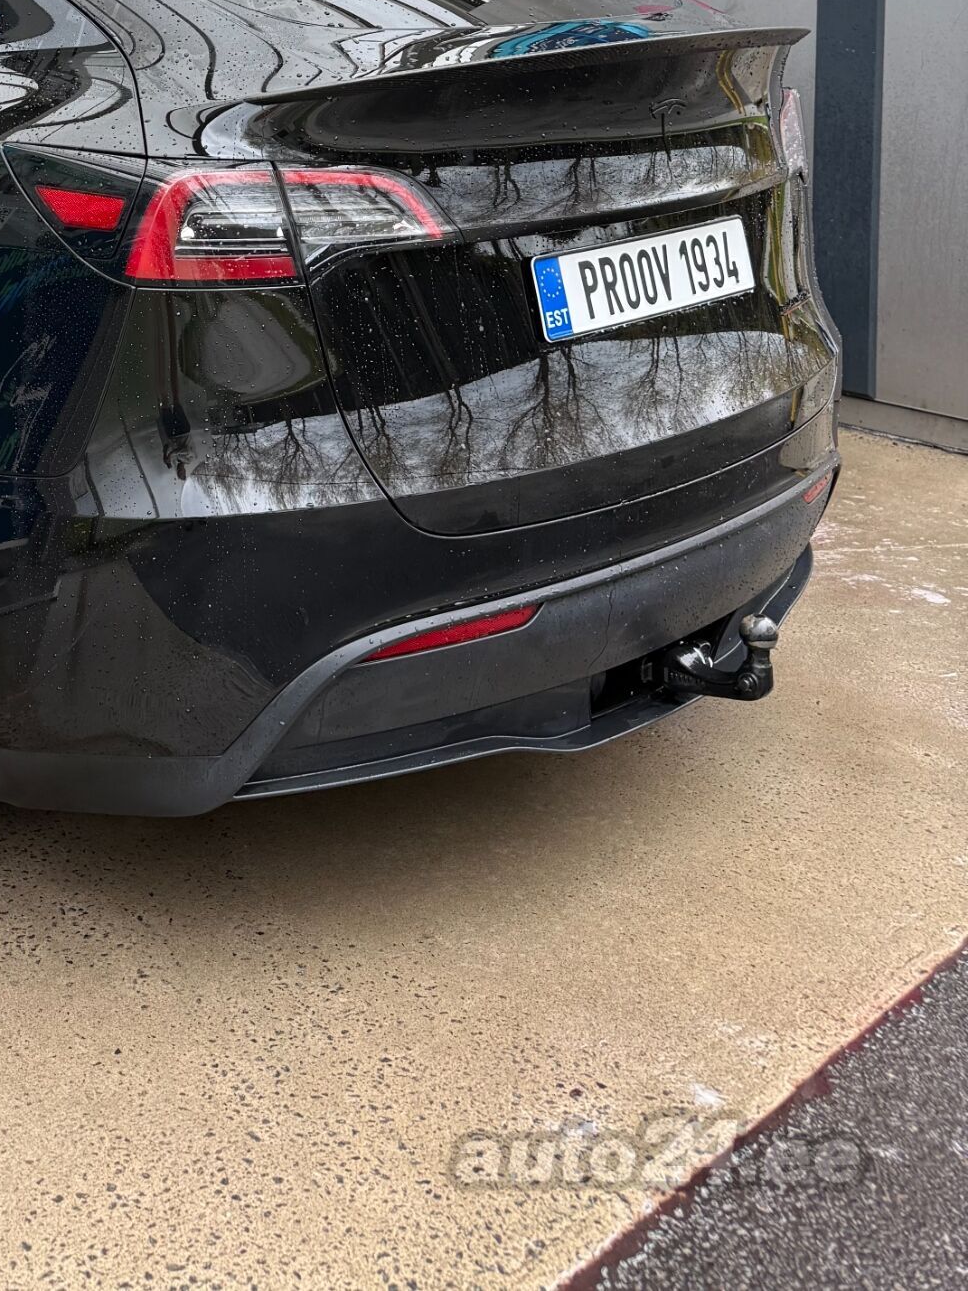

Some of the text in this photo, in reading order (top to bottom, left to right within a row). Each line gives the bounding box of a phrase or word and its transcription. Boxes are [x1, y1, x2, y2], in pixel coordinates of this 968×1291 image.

[578, 231, 740, 321] PROOV 1934
[546, 308, 570, 329] EST
